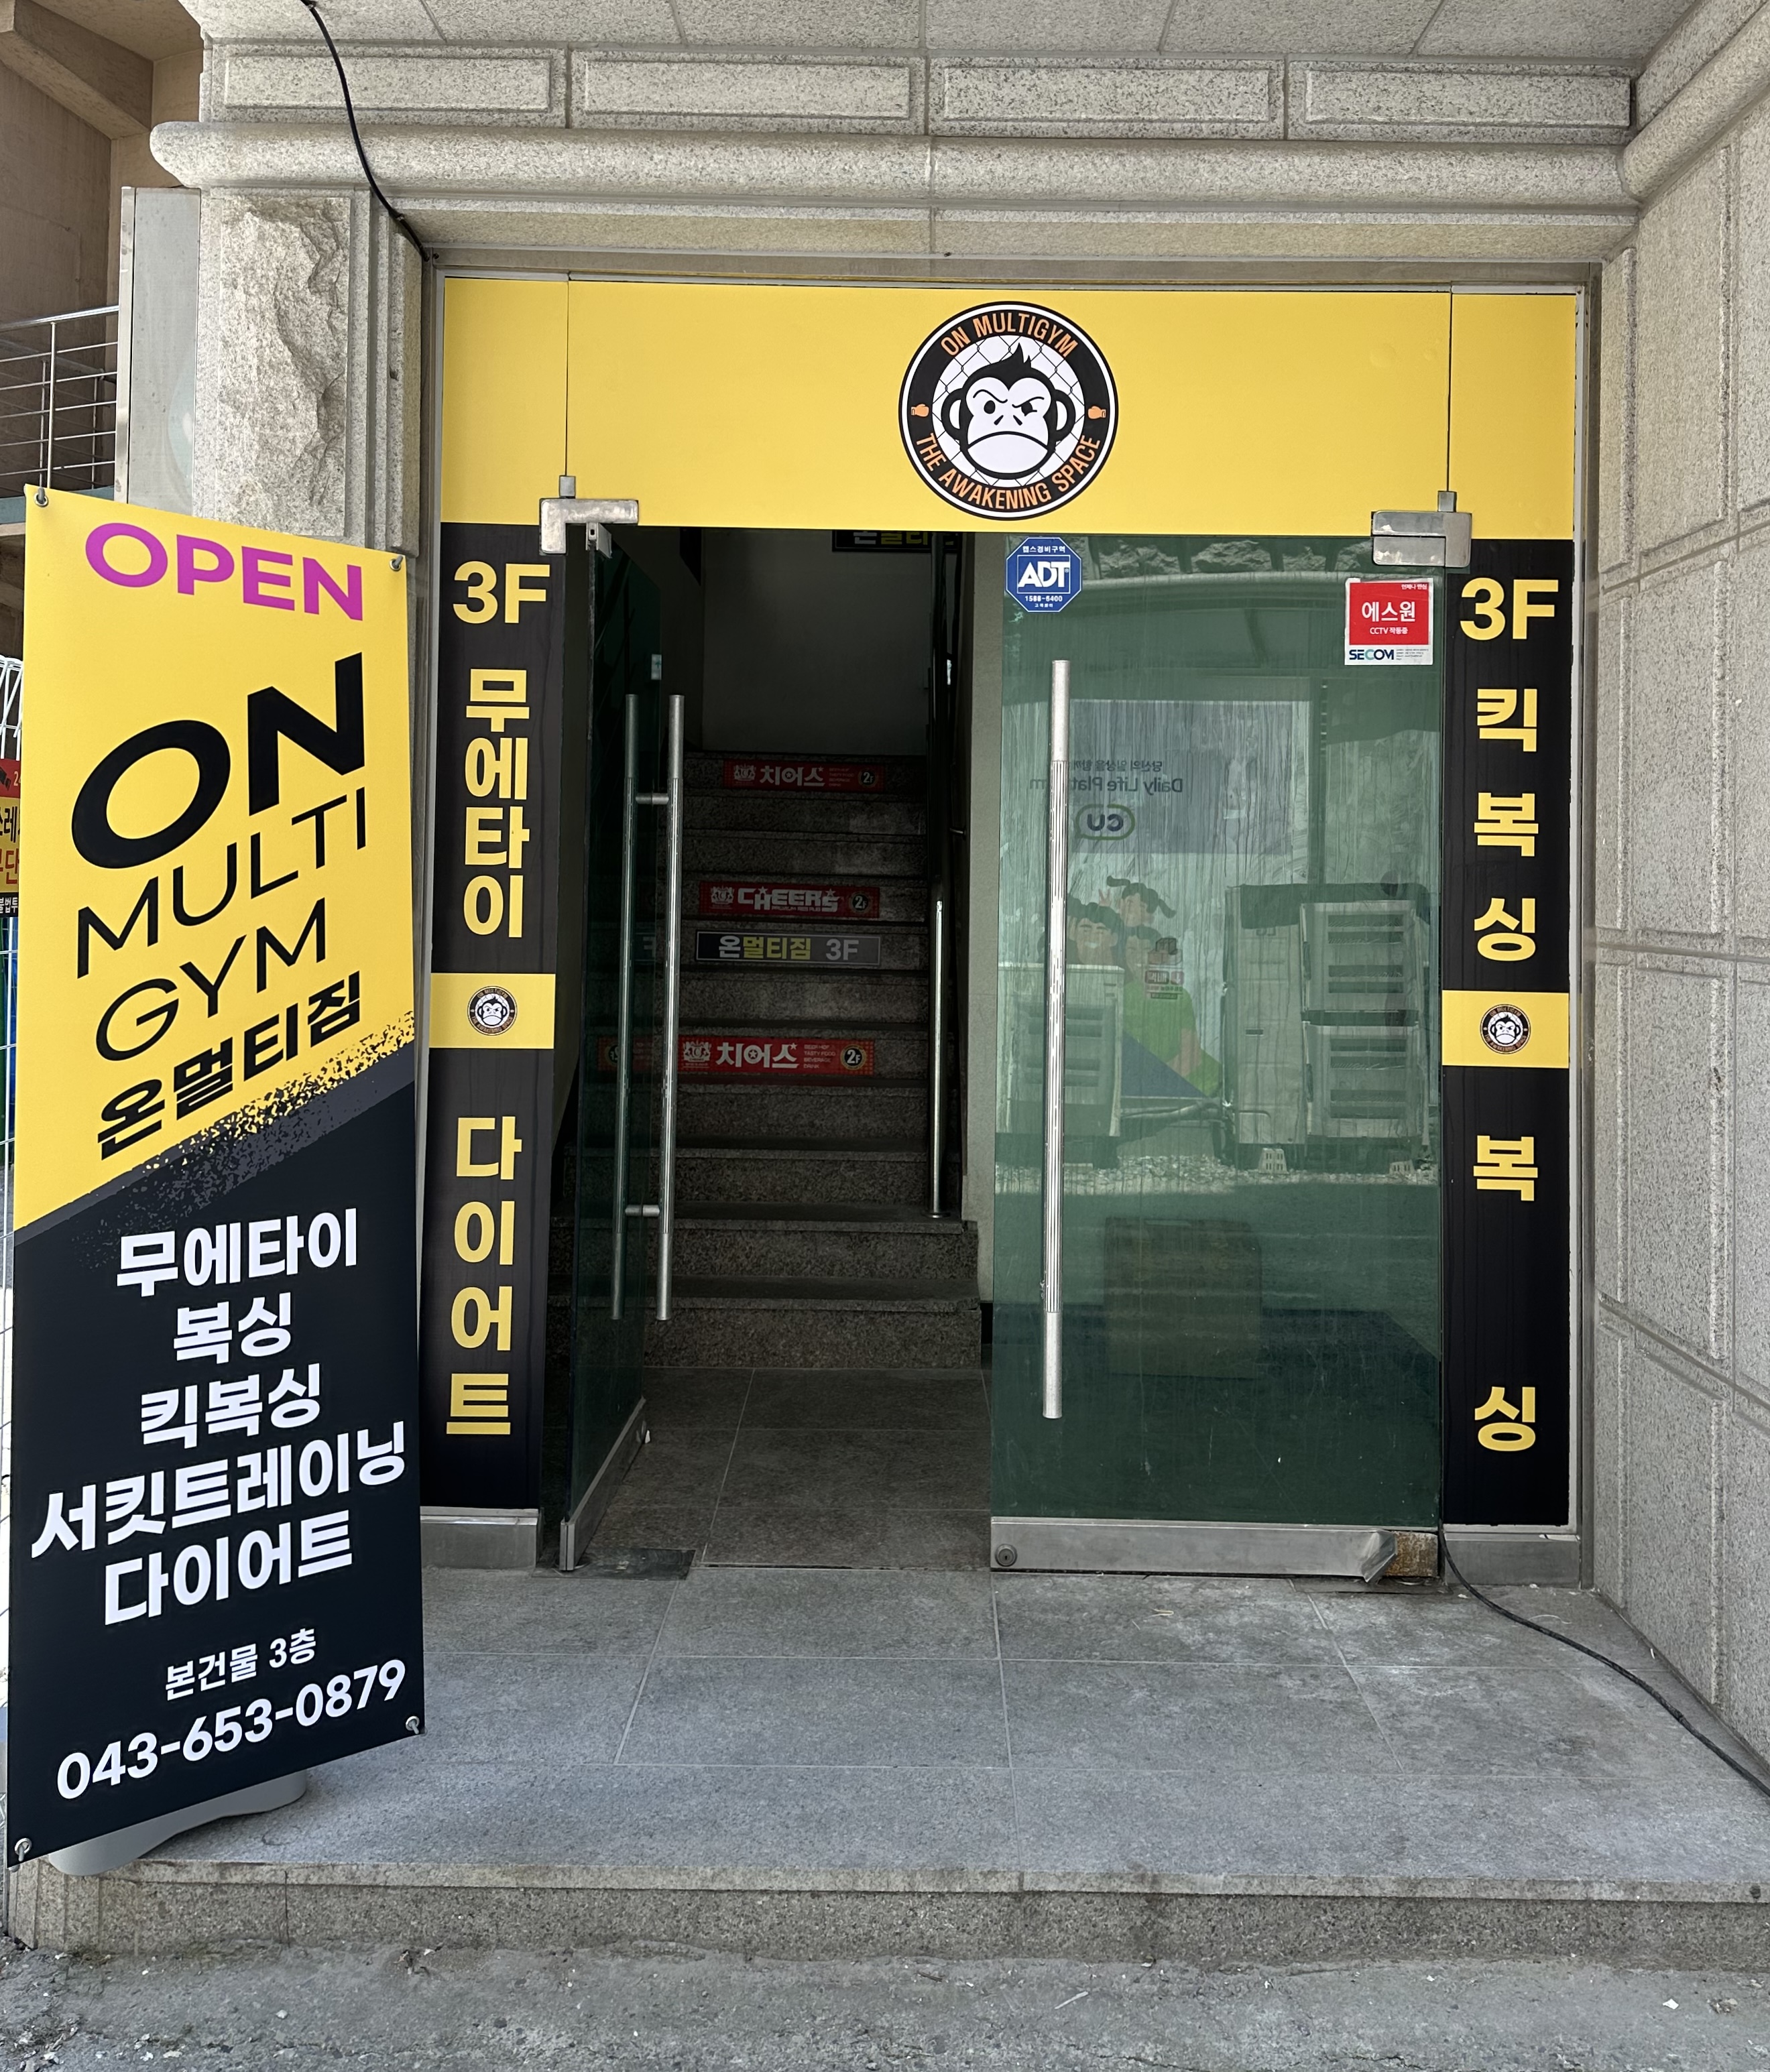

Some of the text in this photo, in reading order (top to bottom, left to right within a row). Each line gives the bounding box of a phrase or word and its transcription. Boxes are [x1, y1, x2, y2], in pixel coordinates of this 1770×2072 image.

[941, 312, 1078, 357] ON MULTIGYM
[916, 432, 1100, 509] THE AWAKENING SPACE
[85, 523, 363, 621] OPEN
[453, 560, 550, 623] 3F
[1018, 561, 1071, 587] ADT
[1362, 601, 1415, 622] 에스원
[1370, 627, 1389, 635] CCTV
[1460, 578, 1559, 640] 3F
[1349, 649, 1395, 660] SECOM
[71, 652, 365, 869] ON
[760, 765, 825, 786] 치어스
[863, 772, 874, 783] 2F
[463, 668, 530, 937] 무에타이
[1474, 688, 1539, 961] 킥복싱
[78, 787, 365, 979] MULTI
[738, 886, 840, 912] CHEERS
[855, 896, 868, 908] 2F
[96, 898, 325, 1061] GYM
[719, 935, 860, 961] 온멀티짐 3F
[97, 970, 360, 1160] 온멀티짐
[715, 1042, 800, 1069] 치어스
[847, 1049, 861, 1064] 2F
[117, 1208, 357, 1297] 무에타이
[446, 1115, 522, 1435] 다이어트
[173, 1292, 292, 1364] 복싱
[1473, 1135, 1538, 1451] 복싱
[141, 1363, 320, 1449] 킥복싱
[31, 1421, 405, 1559] 서킷트레이닝
[105, 1510, 353, 1626] 다이어트
[165, 1628, 316, 1701] 본건물 3층
[57, 1660, 406, 1800] 043-653-0879
